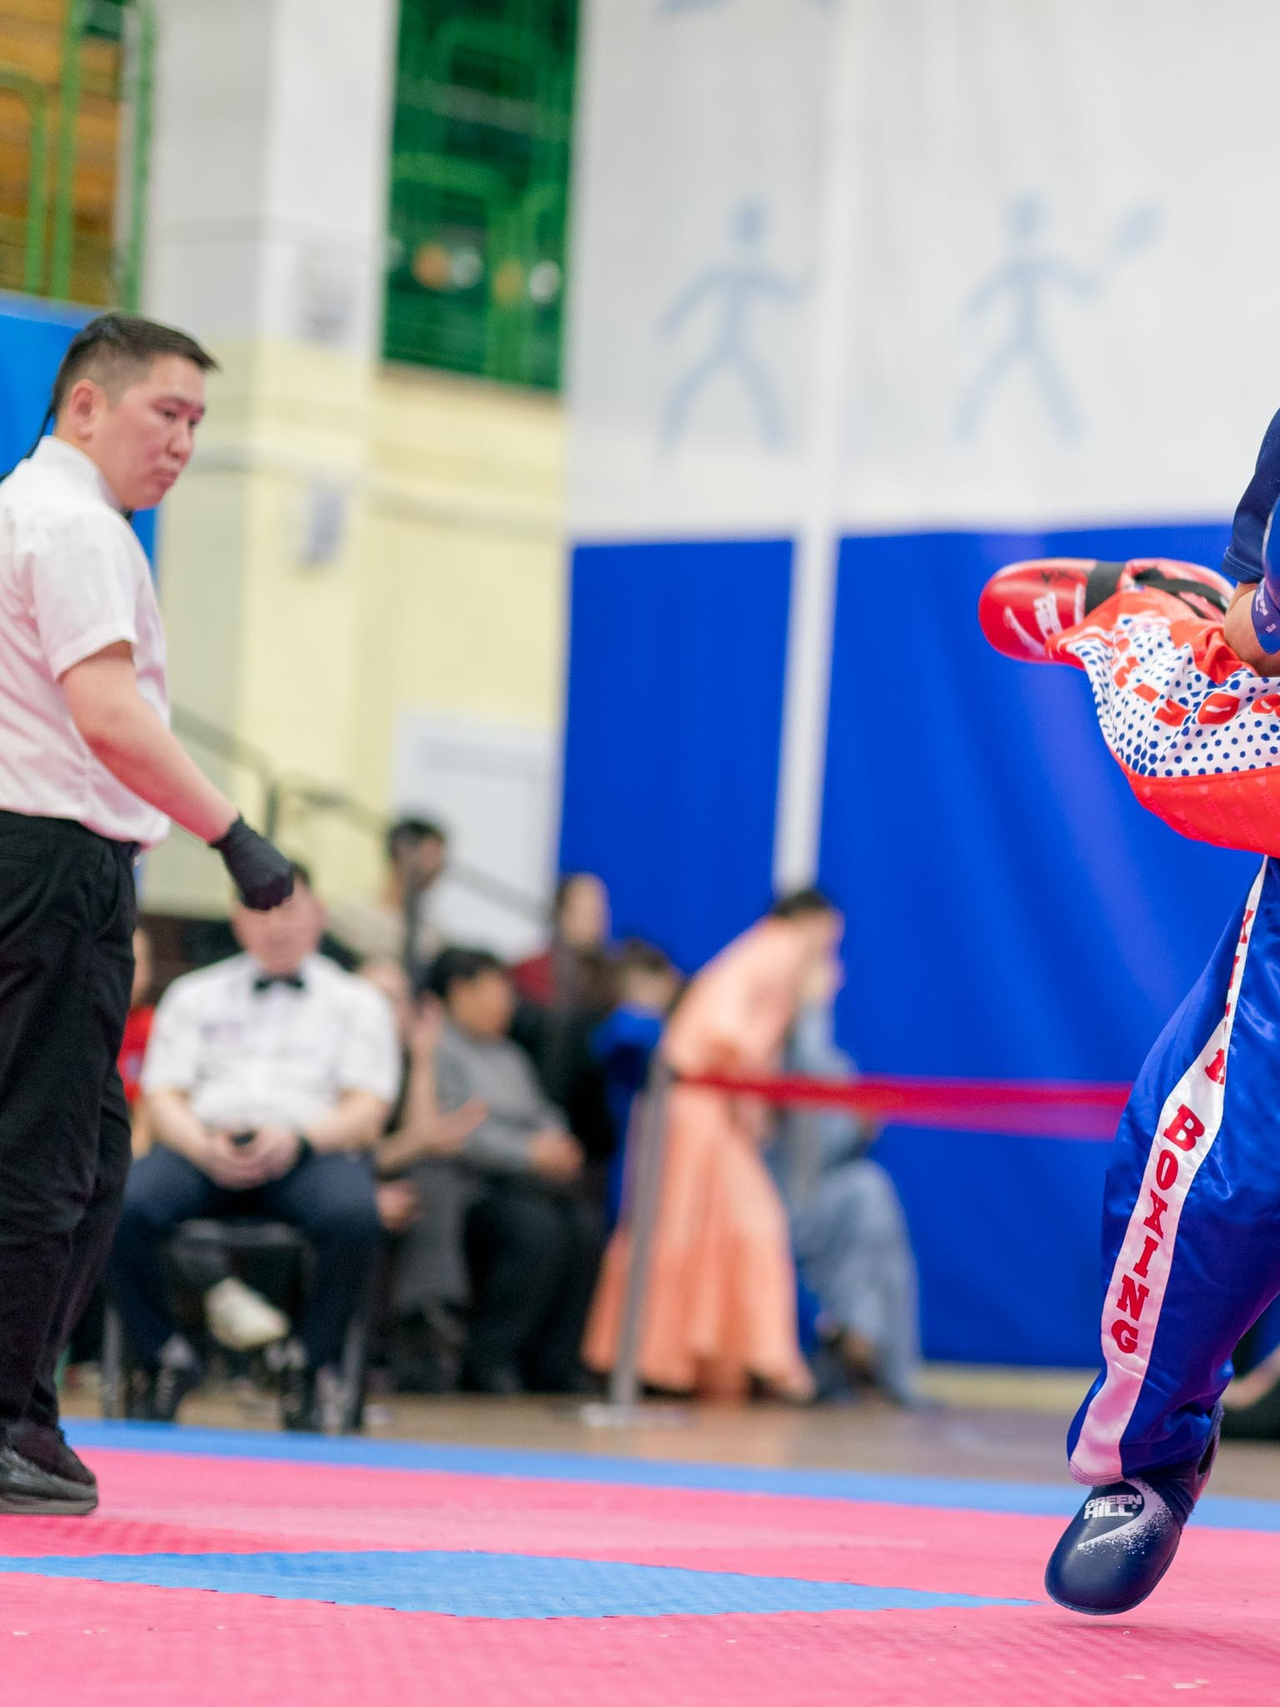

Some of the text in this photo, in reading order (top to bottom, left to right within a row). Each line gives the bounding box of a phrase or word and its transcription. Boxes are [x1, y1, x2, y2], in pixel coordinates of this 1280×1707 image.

[1111, 1104, 1205, 1354] BOXING
[1085, 1495, 1142, 1508] GREEN
[1083, 1504, 1134, 1519] HILL
